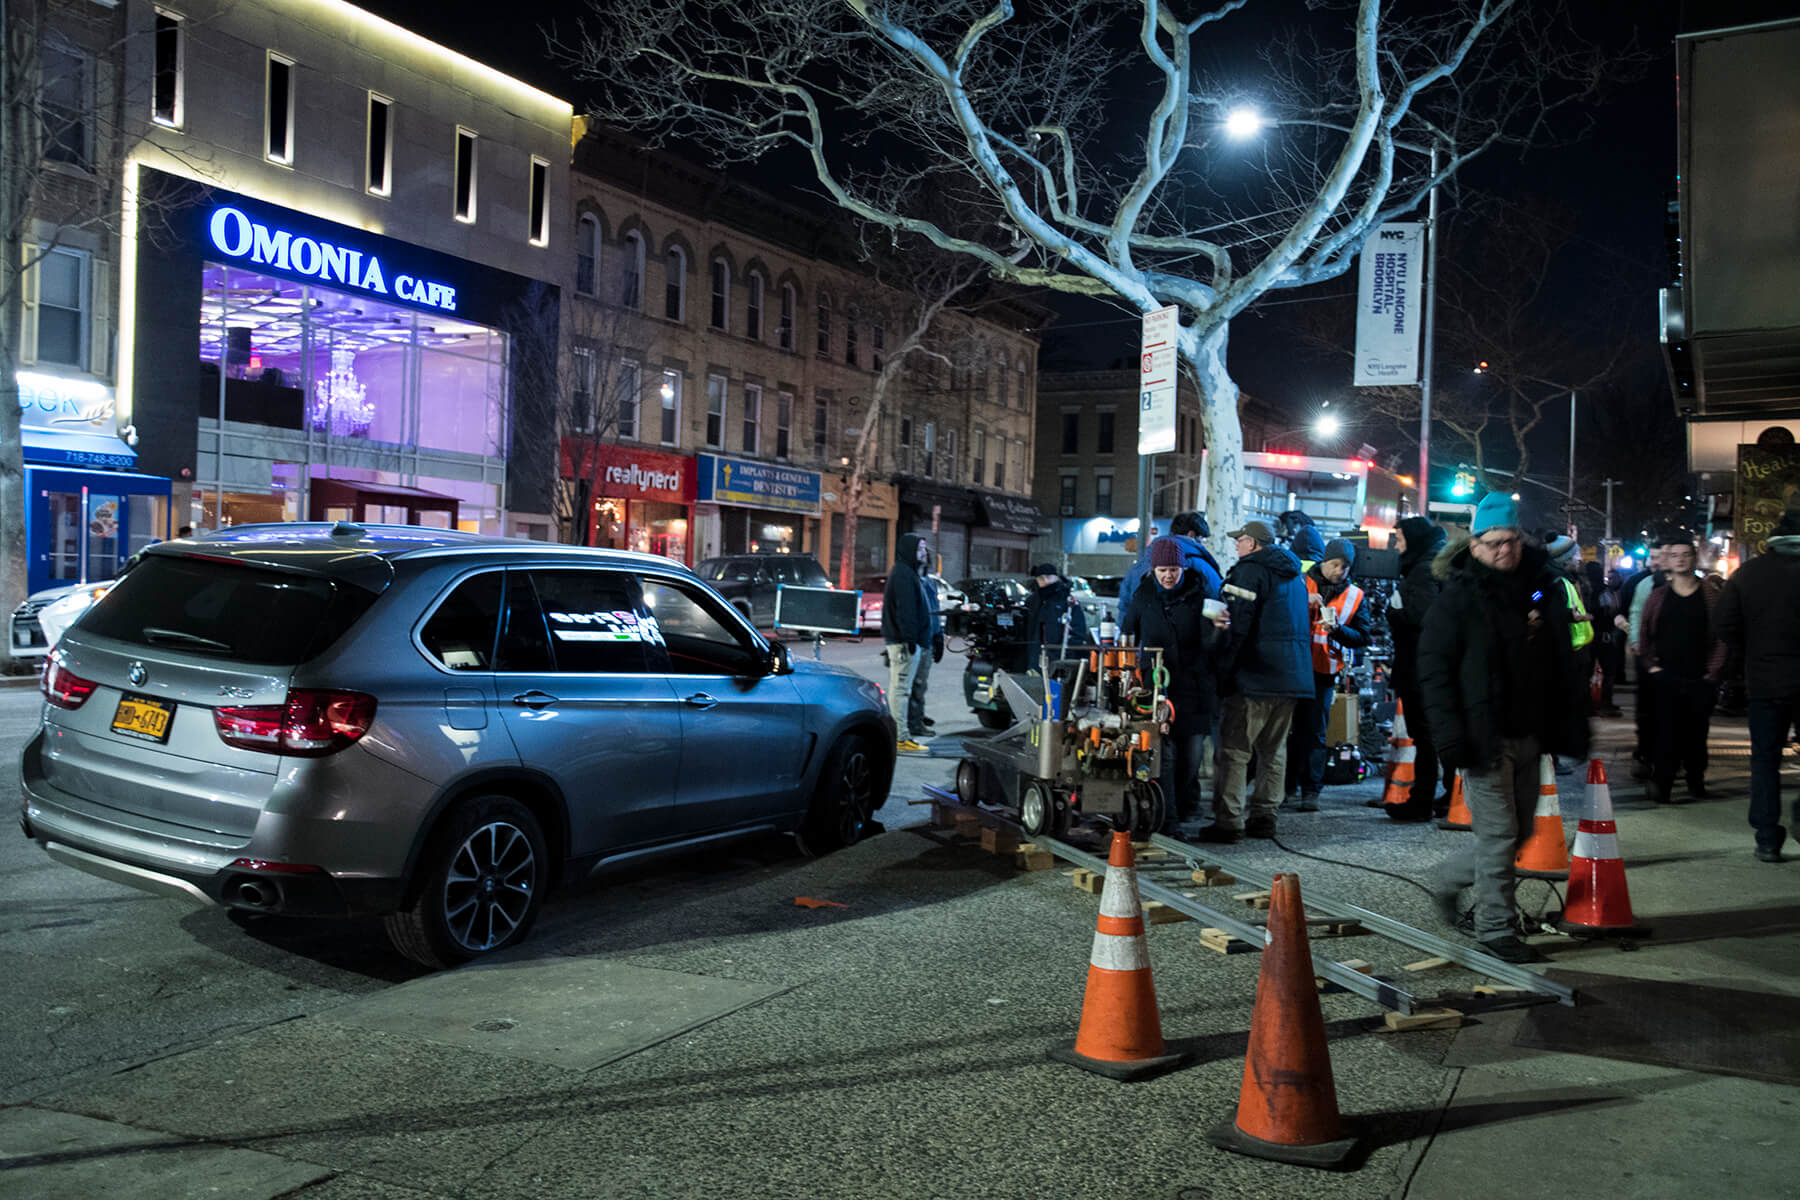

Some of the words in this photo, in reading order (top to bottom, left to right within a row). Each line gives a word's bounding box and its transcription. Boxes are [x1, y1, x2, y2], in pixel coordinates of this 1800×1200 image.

[1380, 230, 1405, 240] NYC
[210, 207, 388, 293] OMONIA
[395, 275, 456, 311] CAFE
[1397, 253, 1407, 278] NYU
[1372, 253, 1385, 314] BROOKLYN
[1394, 281, 1406, 334] LANGONE
[605, 463, 679, 491] realtynerd
[739, 464, 775, 480] IMPLANTS
[781, 472, 811, 485] GENERAL
[753, 480, 797, 497] DENTISTRY
